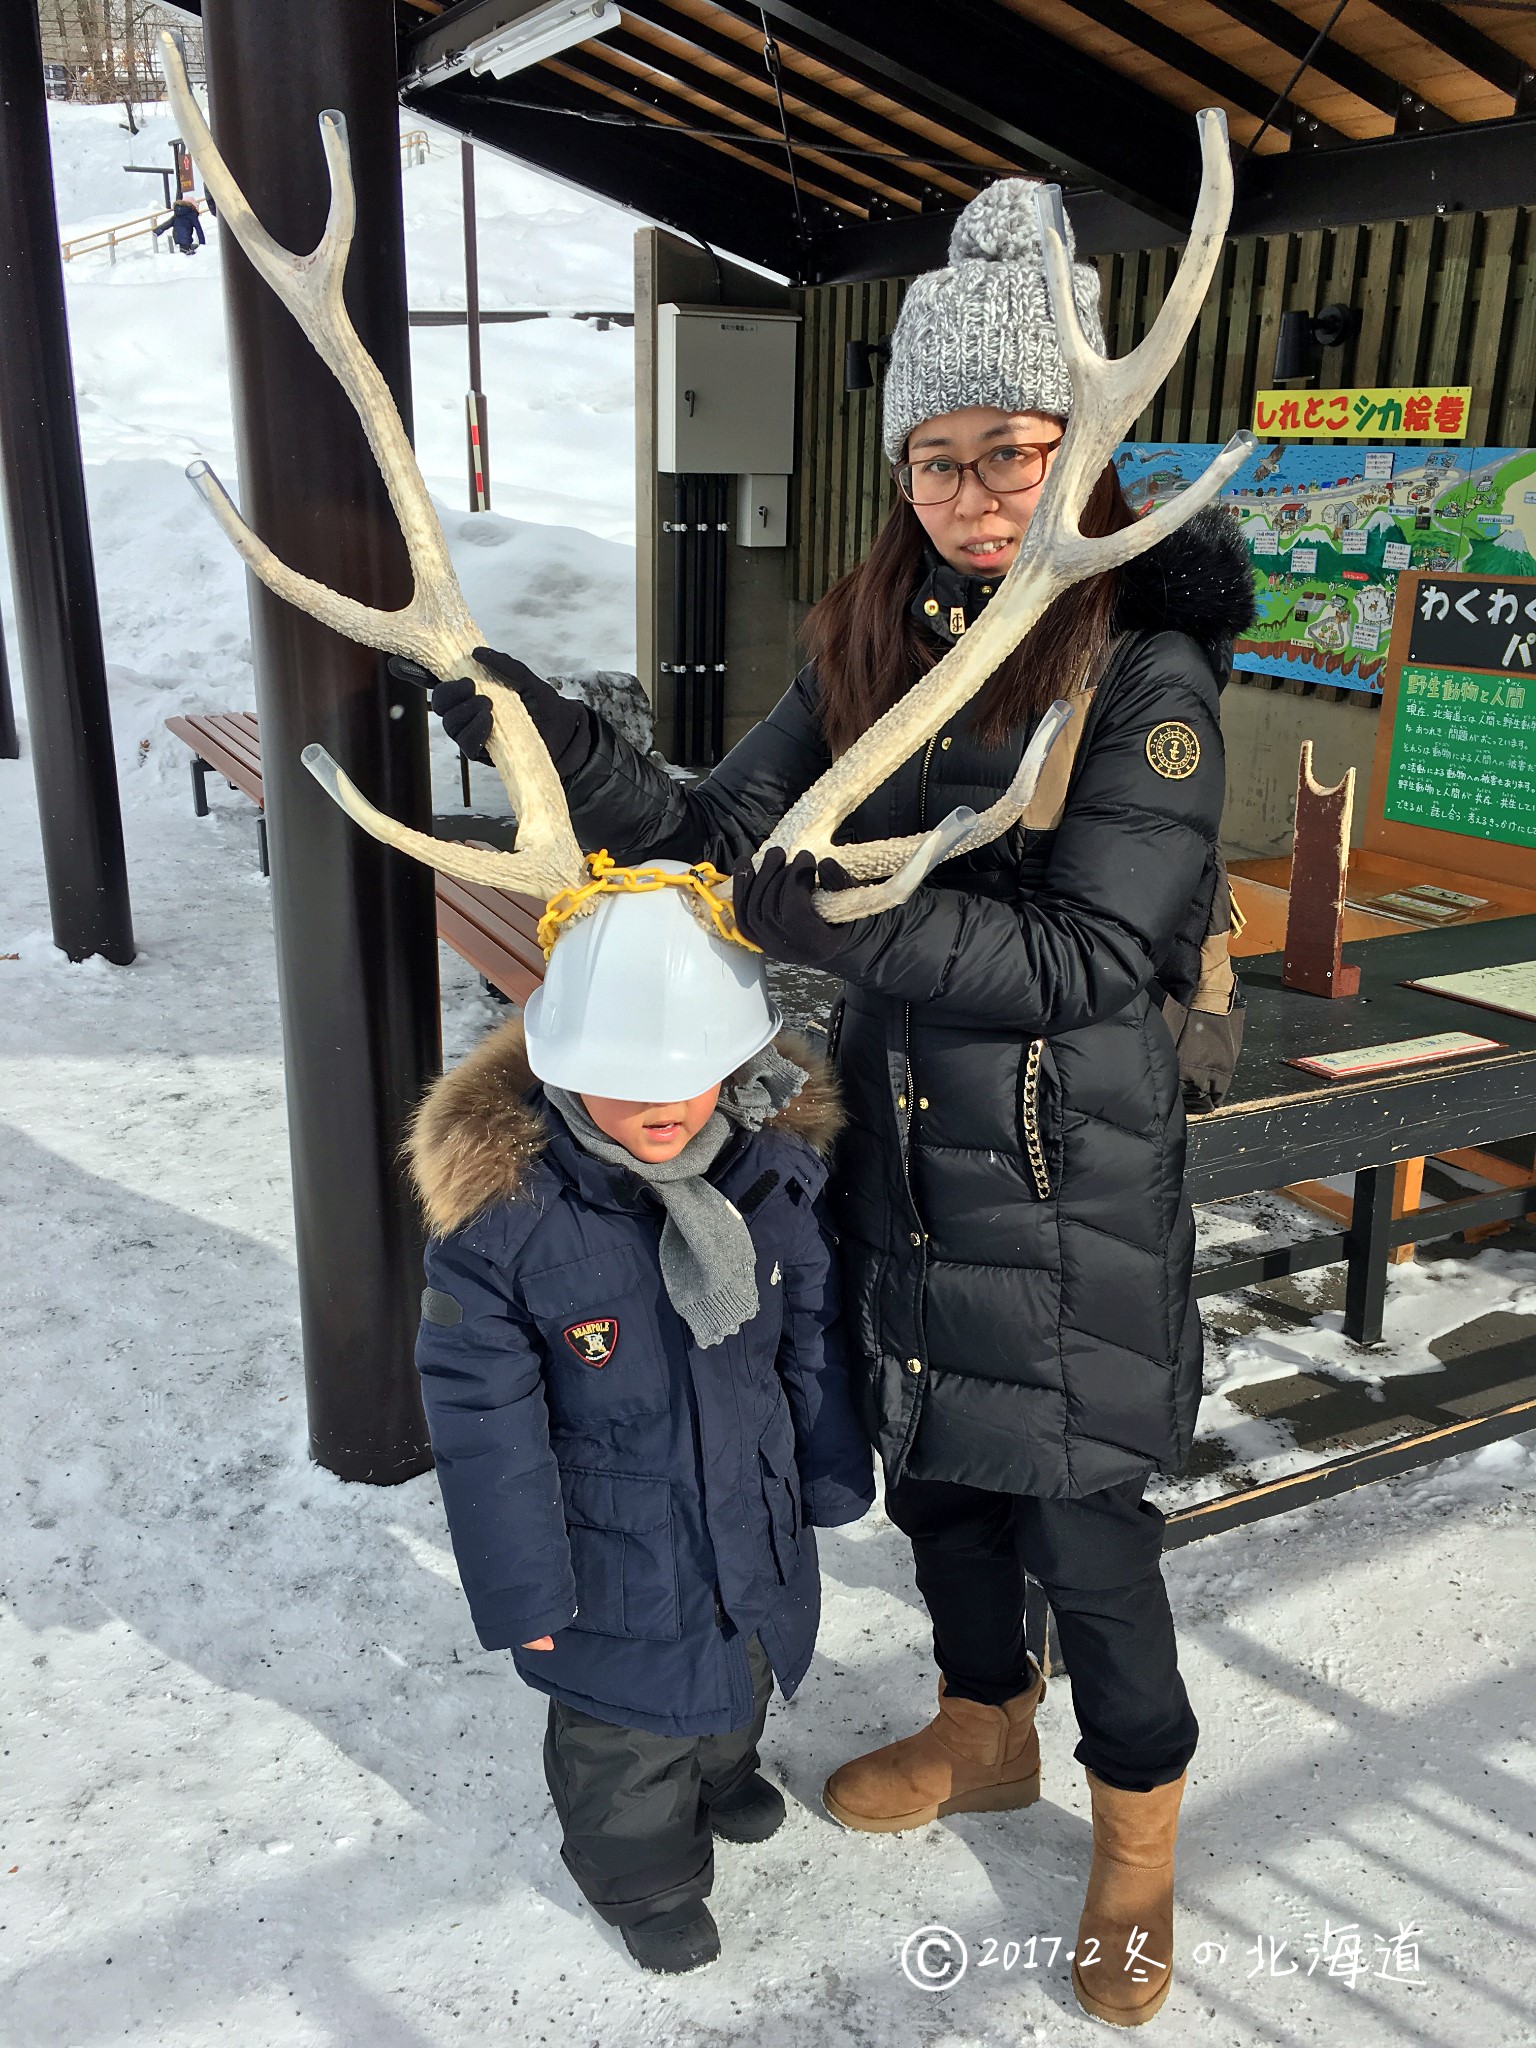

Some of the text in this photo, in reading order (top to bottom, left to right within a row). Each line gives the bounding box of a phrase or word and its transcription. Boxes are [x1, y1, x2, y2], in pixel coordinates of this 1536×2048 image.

[1257, 395, 1465, 433] しれとこシカ絵巻
[1406, 674, 1526, 708] 野生動物と人間
[571, 1321, 610, 1339] BEANPOLE
